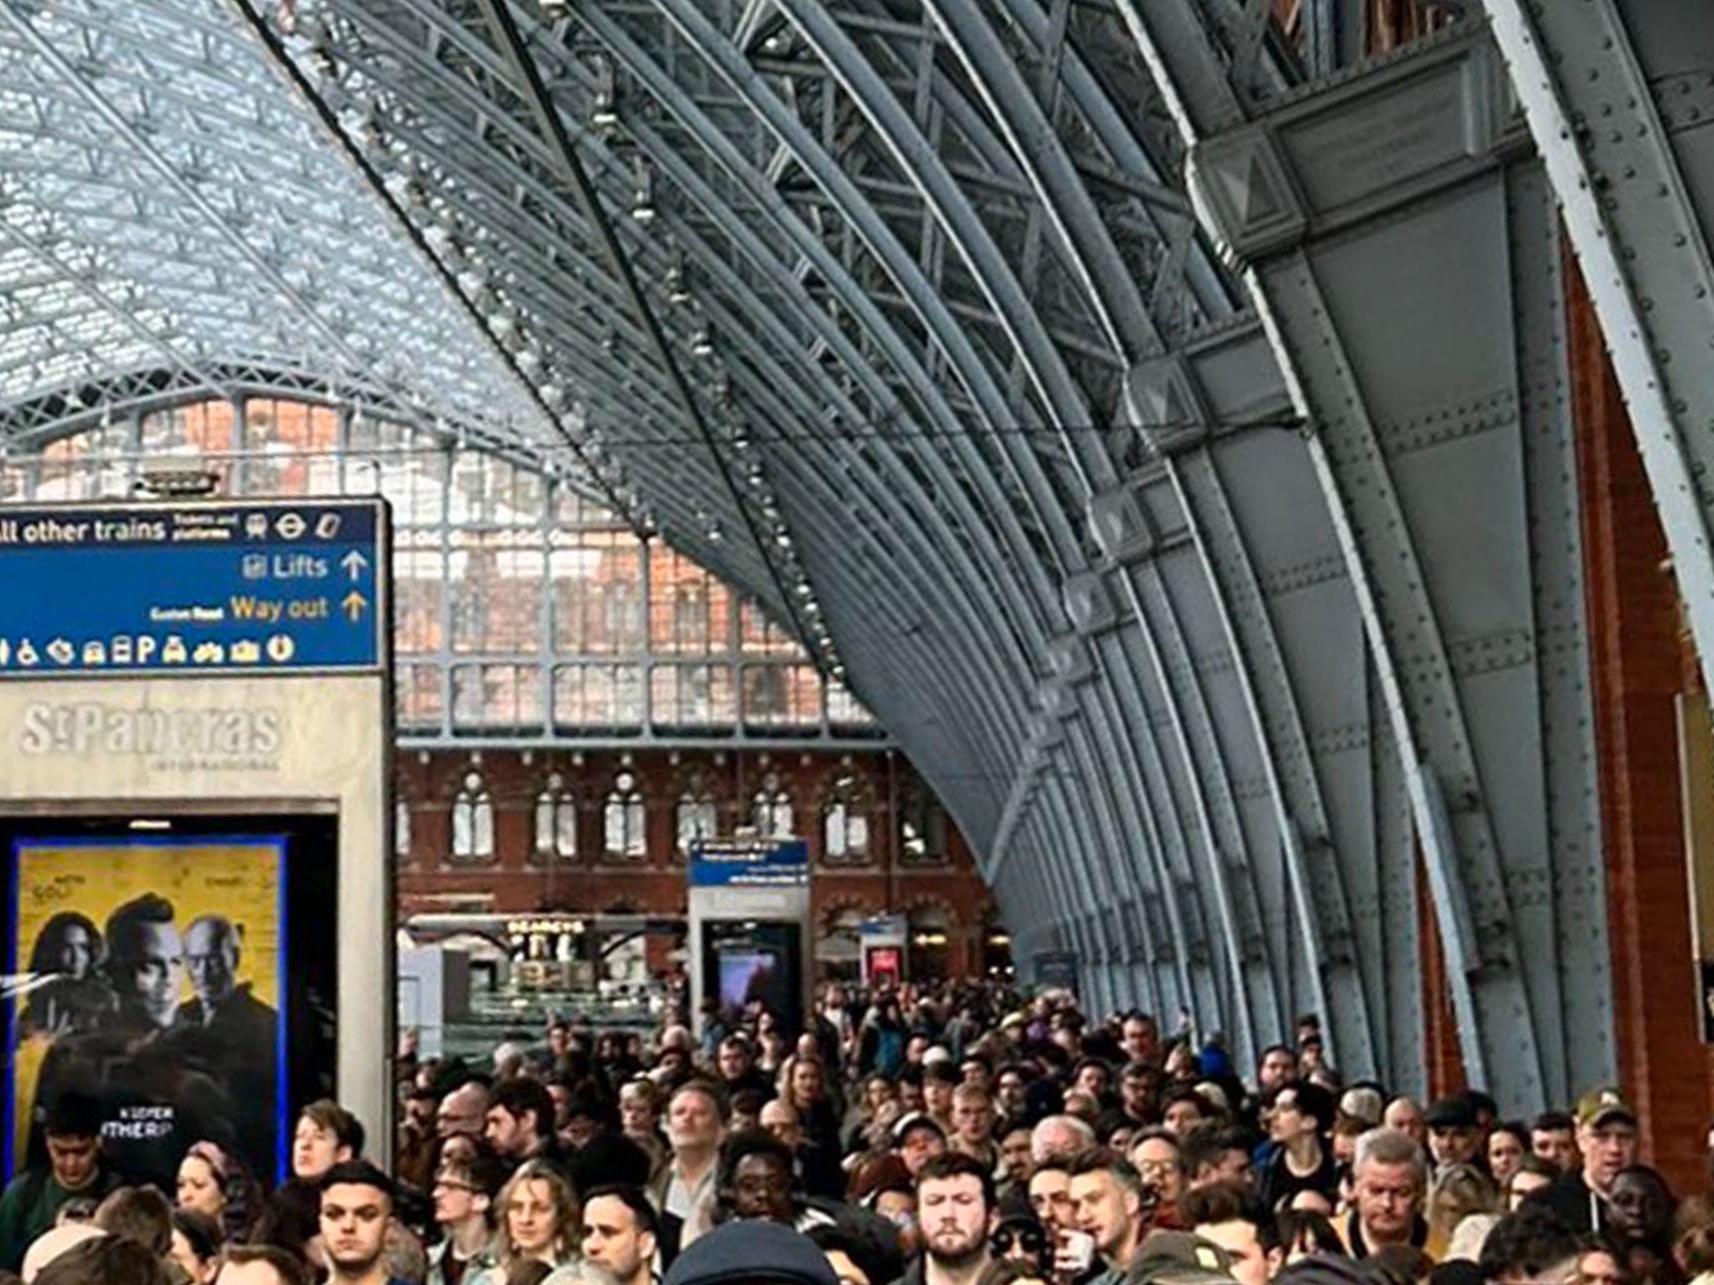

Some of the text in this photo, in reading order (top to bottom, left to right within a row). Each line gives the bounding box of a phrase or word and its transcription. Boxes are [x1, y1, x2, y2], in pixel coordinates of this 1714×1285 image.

[23, 518, 88, 542] other
[94, 518, 166, 541] trains
[273, 554, 329, 578] Lifts
[230, 595, 328, 622] Way out
